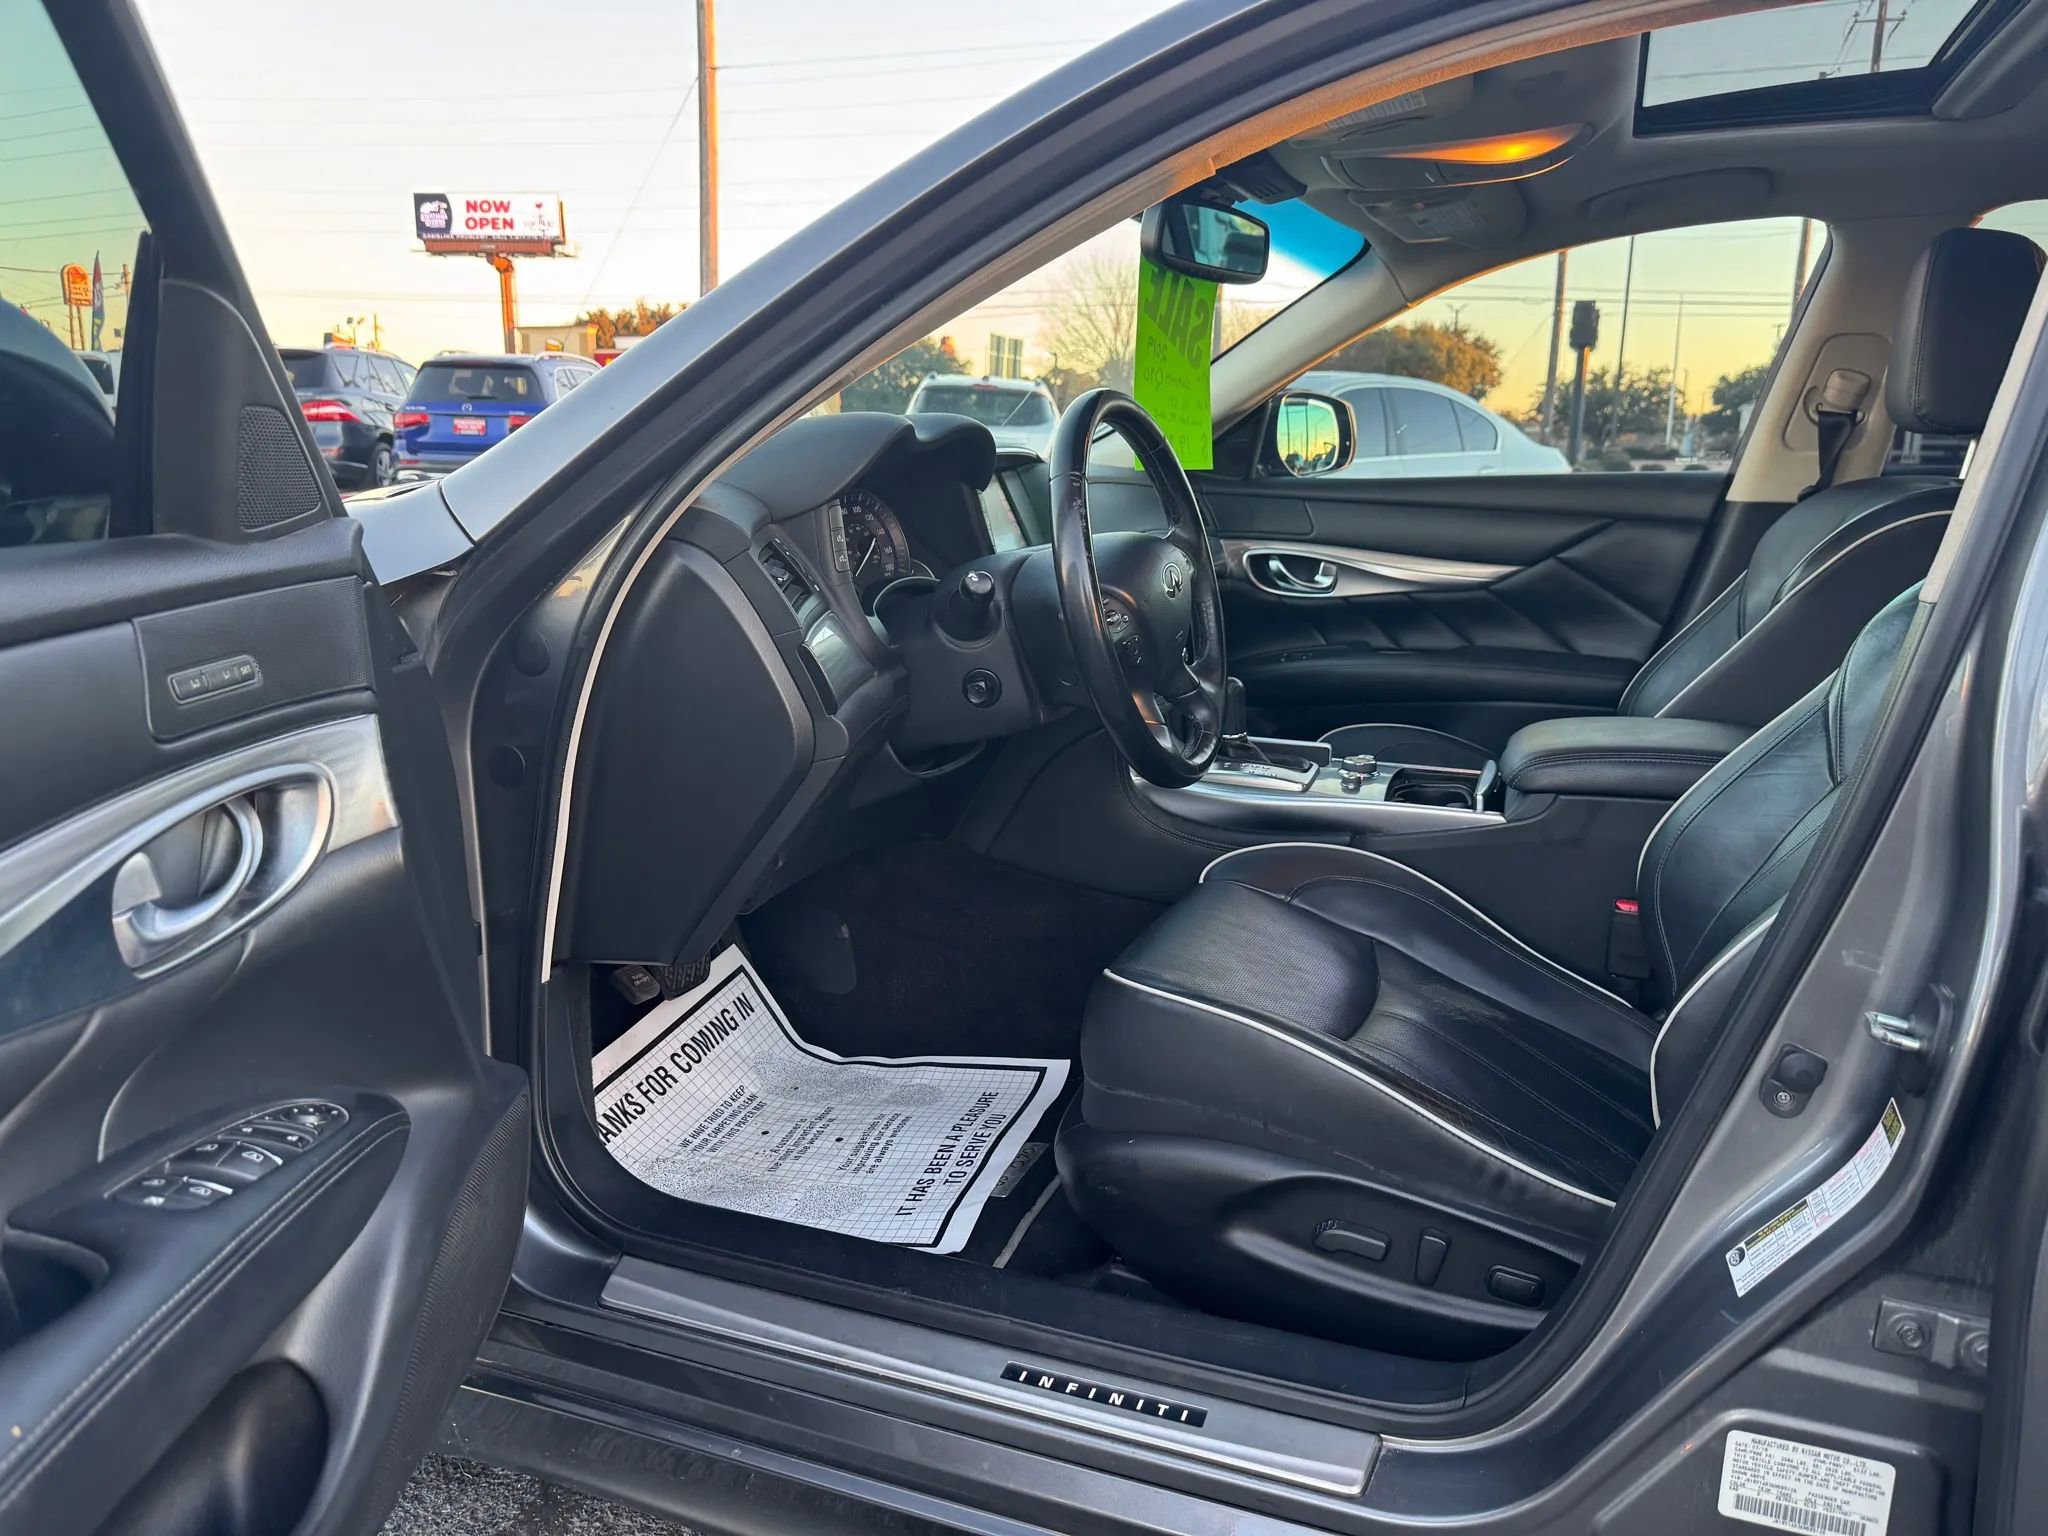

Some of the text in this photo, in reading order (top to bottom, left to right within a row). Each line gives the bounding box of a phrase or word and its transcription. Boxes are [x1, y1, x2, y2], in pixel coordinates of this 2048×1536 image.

[465, 217, 514, 230] OPEN
[466, 200, 511, 213] NOW
[636, 1066, 679, 1104] FOR
[670, 1008, 739, 1073] COMING
[733, 992, 755, 1020] IN
[678, 1085, 745, 1148] WE HAVE TRIED TO KEEP
[691, 1094, 759, 1153] YOUR CARPETING CLEAN
[706, 1101, 768, 1153] WITH THIS PAPER MAT
[951, 1091, 999, 1132] PLEASURE
[836, 1158, 854, 1171] Your
[850, 1121, 880, 1156] suggestions
[874, 1131, 885, 1141] our
[874, 1140, 894, 1163] always
[943, 1113, 1006, 1185] TO SERVE YOU
[767, 1162, 782, 1172] the
[924, 1144, 956, 1174] BEEN
[905, 1178, 935, 1202] HAS
[895, 1205, 916, 1216] IT
[1018, 1371, 1189, 1421] INFINITI
